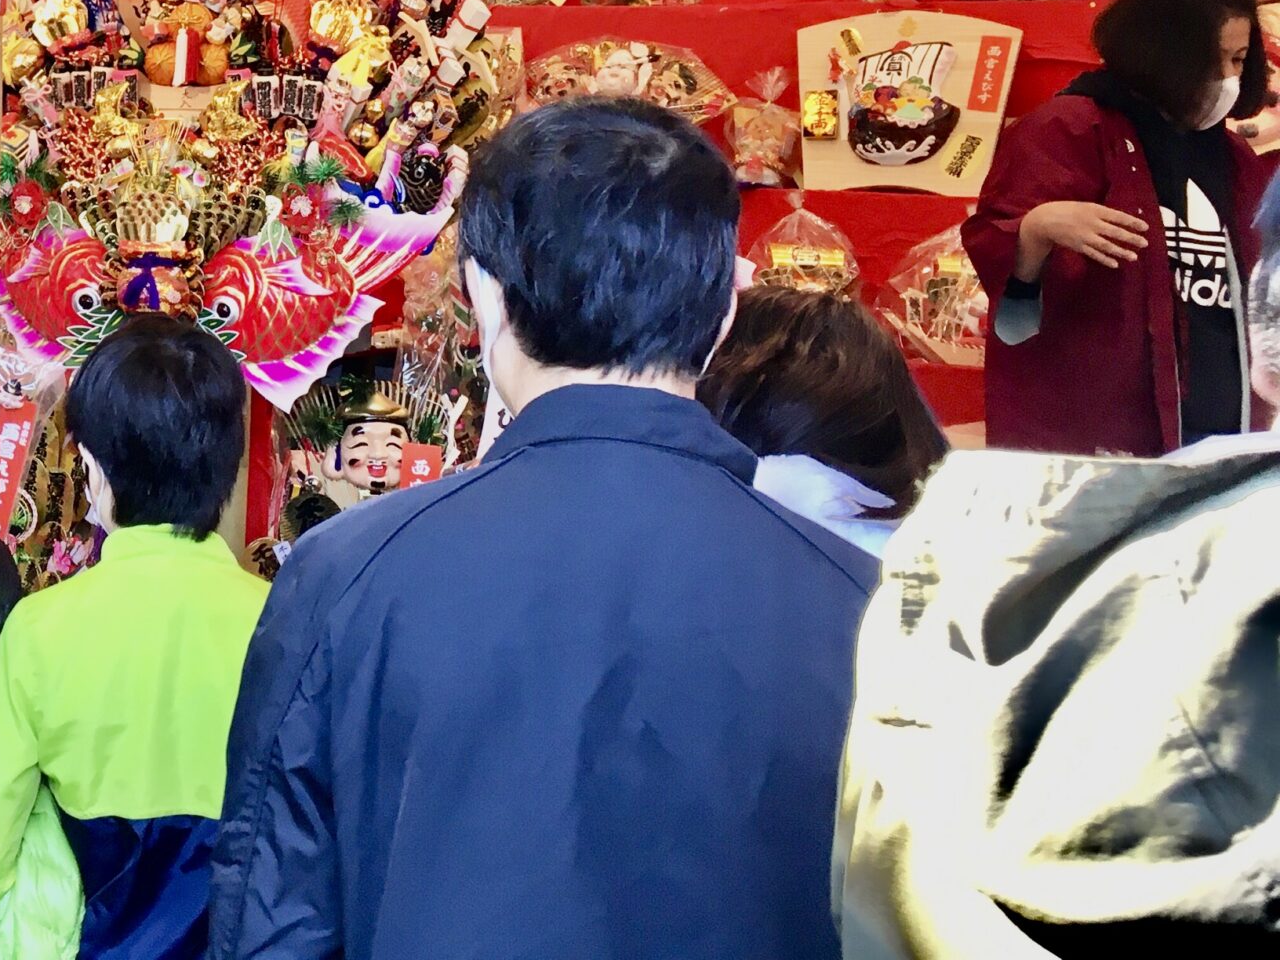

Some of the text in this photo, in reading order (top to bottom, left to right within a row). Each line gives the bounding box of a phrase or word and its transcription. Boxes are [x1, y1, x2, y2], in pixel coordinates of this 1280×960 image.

[977, 46, 1002, 104] 西宮えびす
